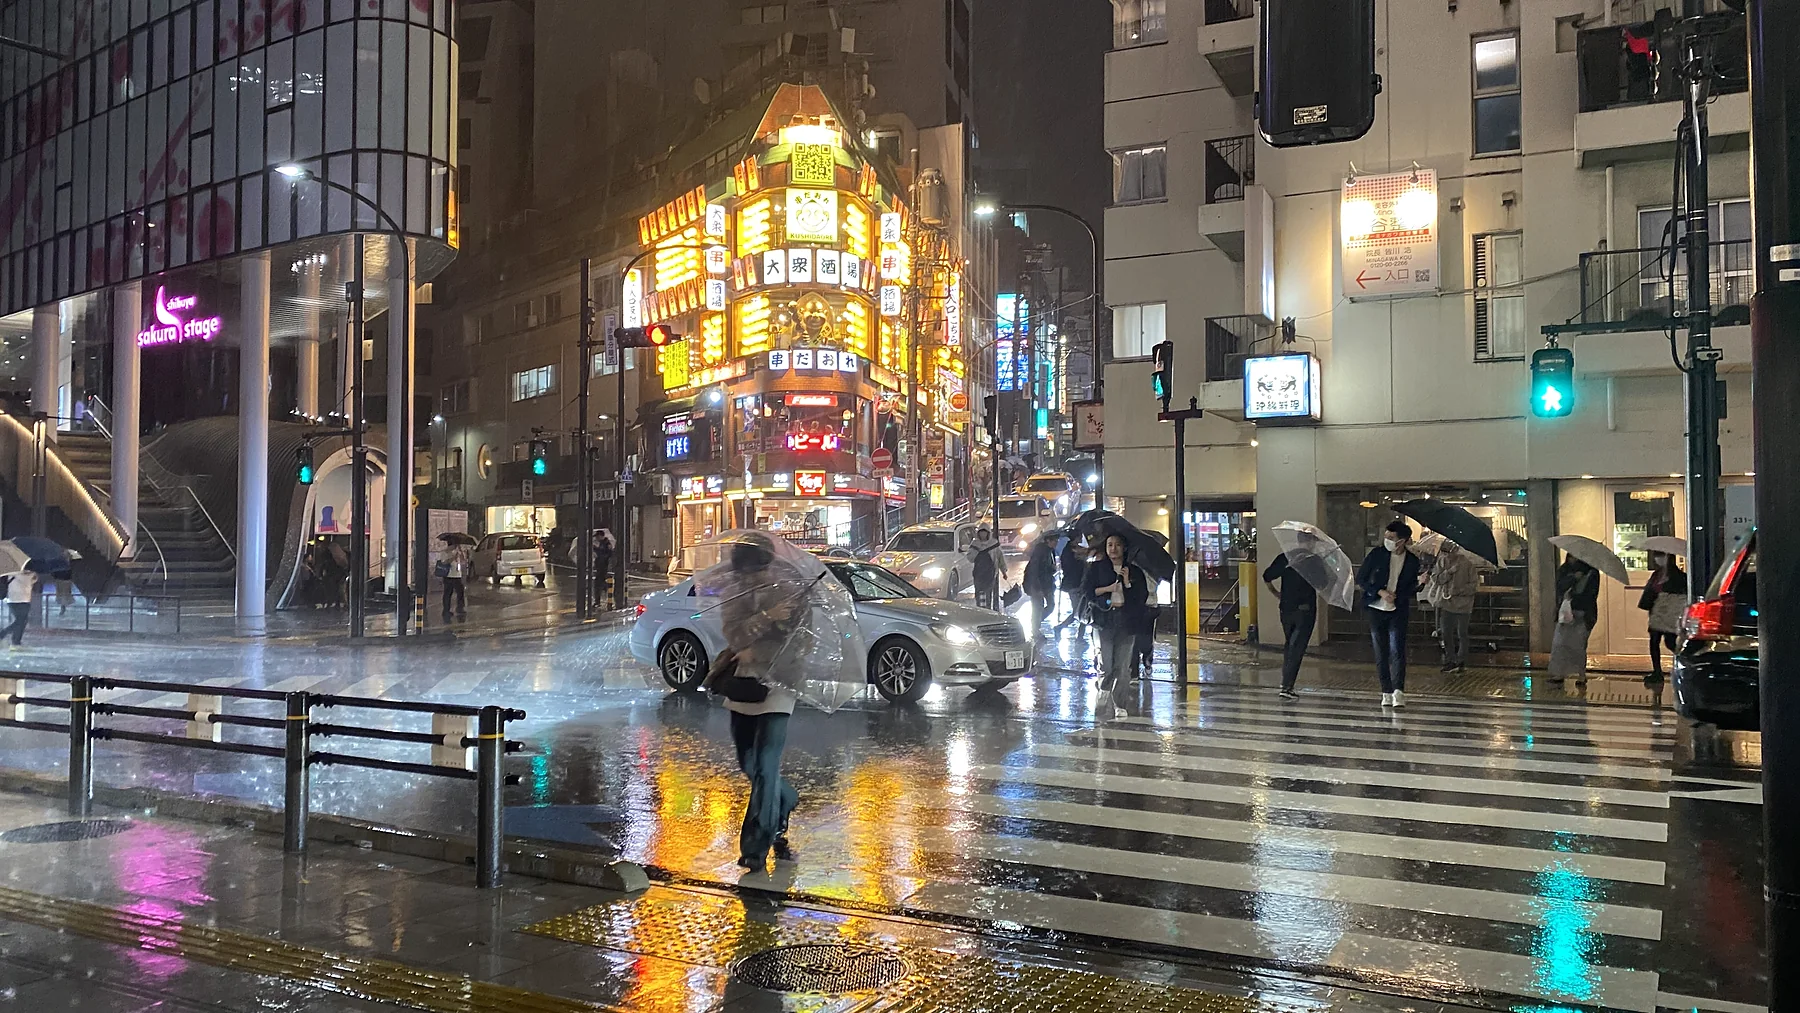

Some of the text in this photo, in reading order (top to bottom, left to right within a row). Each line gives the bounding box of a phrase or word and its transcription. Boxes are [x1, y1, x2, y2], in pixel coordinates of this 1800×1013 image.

[1375, 201, 1398, 209] 美容外
[790, 232, 833, 241] KUSHIDAORE
[710, 209, 723, 307] 大衆 串 酒場
[882, 215, 897, 313] 大衆 串 酒場
[766, 256, 858, 279] 大衆酒場
[1385, 269, 1409, 281] 入口
[167, 296, 196, 310] shibuya
[137, 317, 219, 346] sakura stage
[771, 351, 855, 369] 串だおれ
[668, 423, 686, 434] Fields
